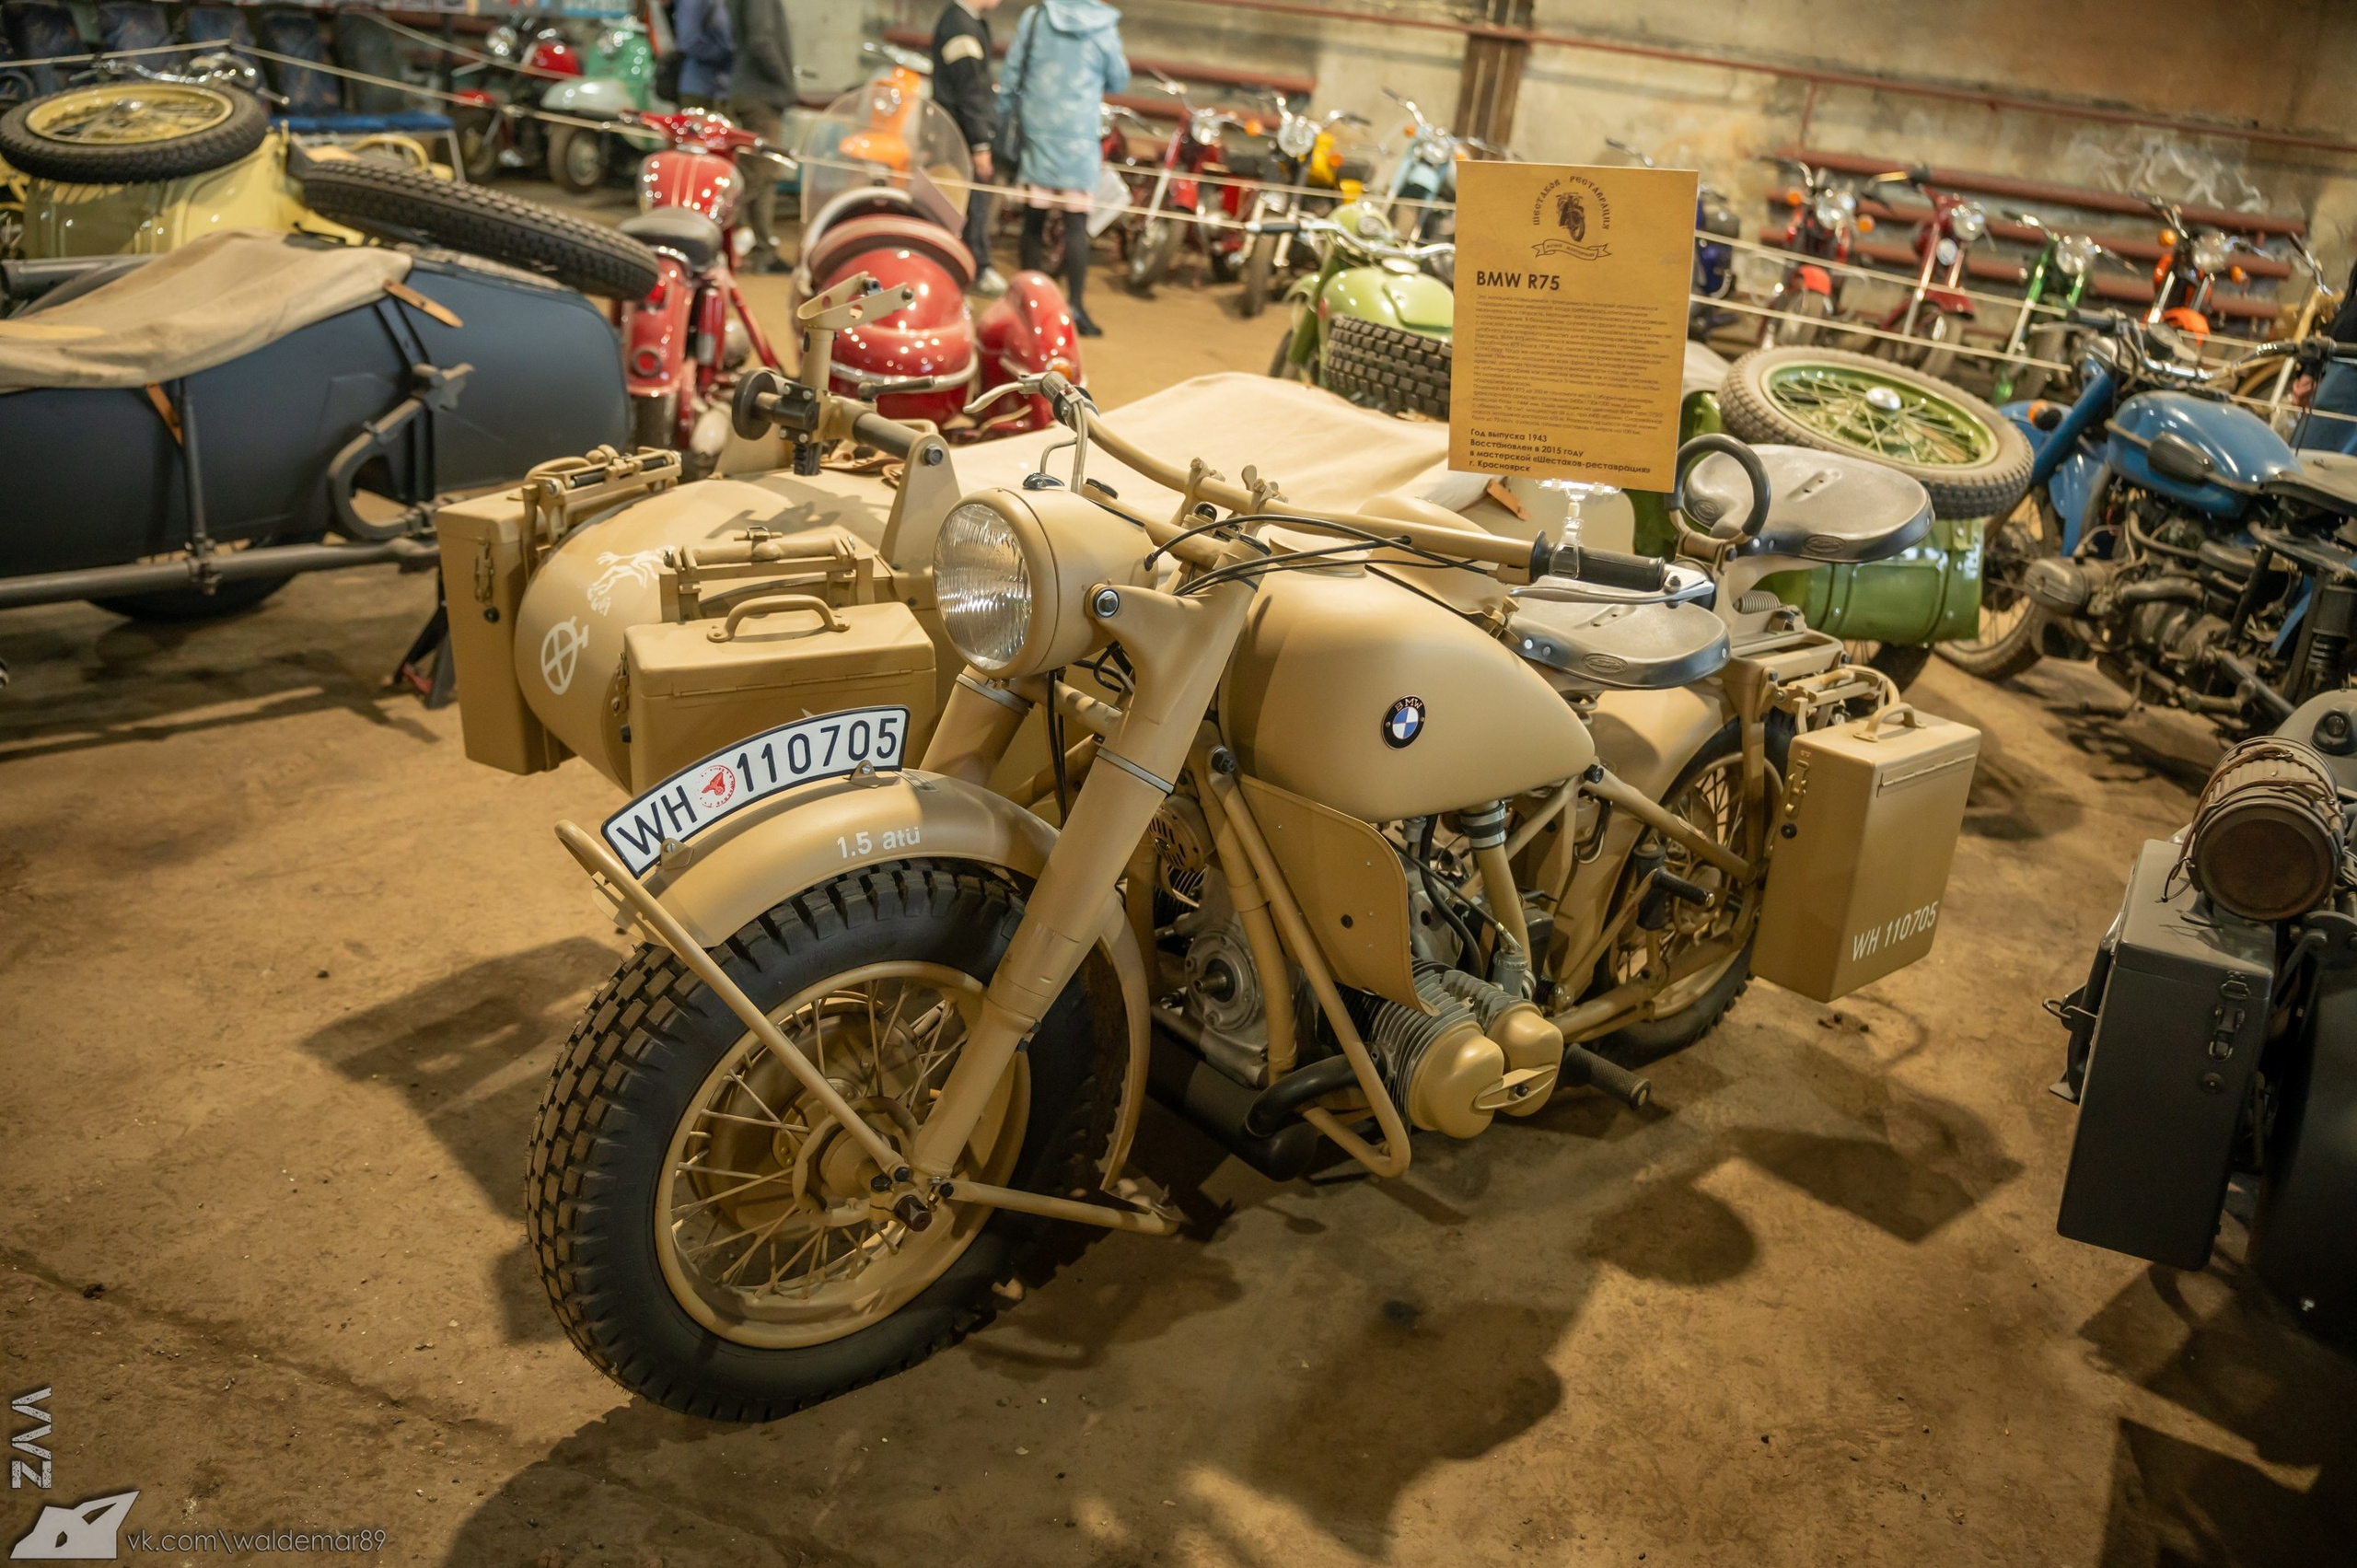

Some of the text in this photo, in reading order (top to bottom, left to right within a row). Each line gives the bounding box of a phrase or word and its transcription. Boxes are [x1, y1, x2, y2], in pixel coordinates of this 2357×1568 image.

[1476, 270, 1560, 291] BMW R75
[1470, 428, 1546, 442] Год выпуска 1943
[1469, 439, 1532, 451] Восстановлен
[1541, 446, 1561, 454] 2015
[1563, 448, 1584, 457] году
[1476, 450, 1530, 462] мастерской
[1477, 460, 1529, 472] Красноярск
[1395, 697, 1422, 712] BMW
[616, 784, 698, 856] WH
[737, 717, 898, 793] 110705
[836, 826, 921, 859] 1.5 atü
[1852, 900, 1939, 962] WH 110705
